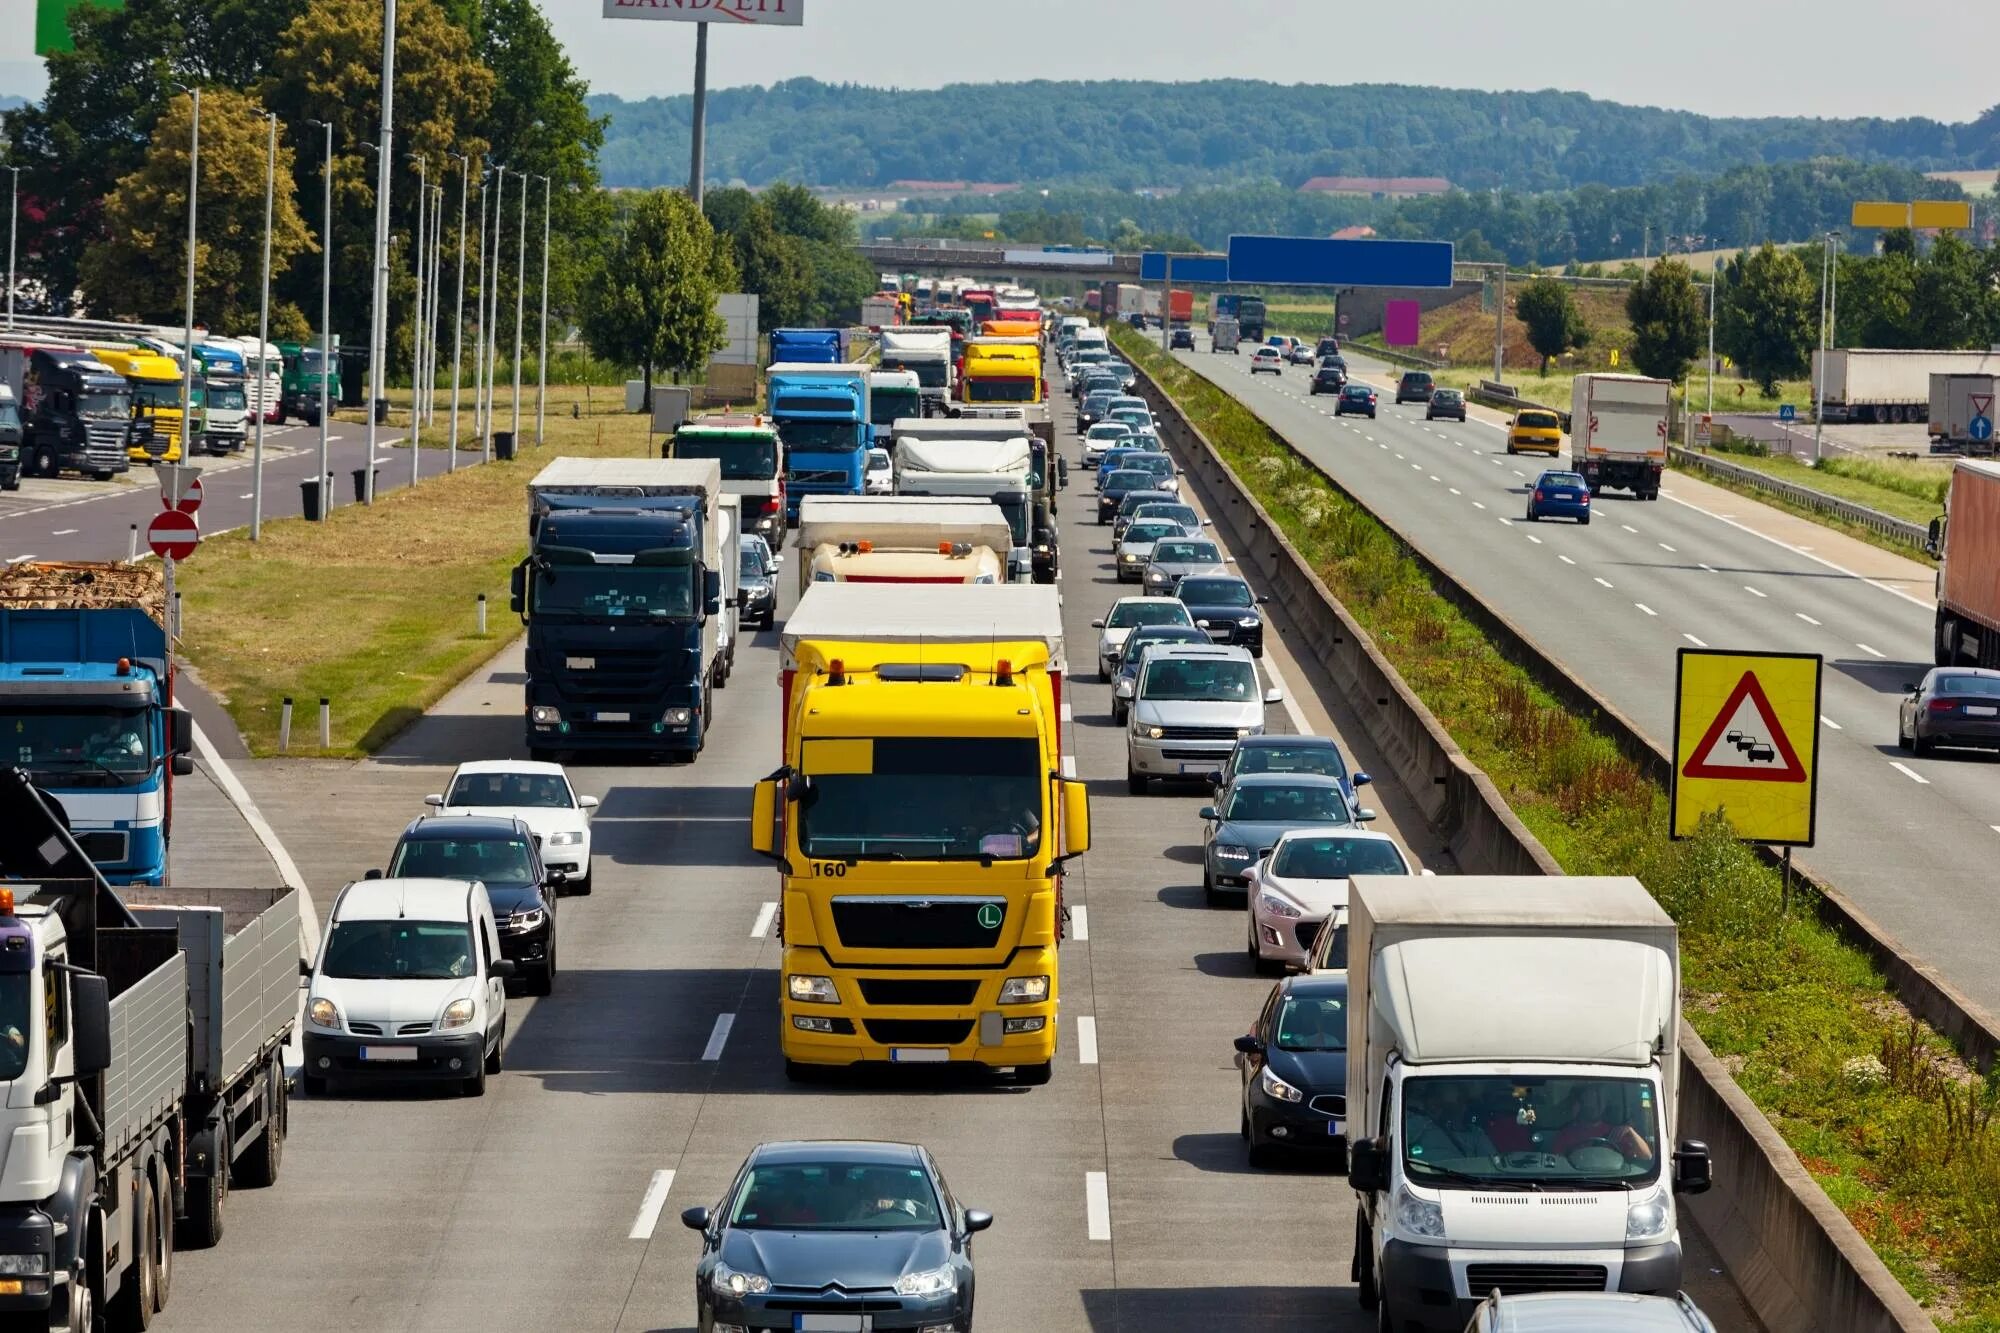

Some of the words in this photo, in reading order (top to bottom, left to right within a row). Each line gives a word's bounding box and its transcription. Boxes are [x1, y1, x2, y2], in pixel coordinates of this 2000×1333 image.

[561, 722, 568, 733] V
[655, 722, 662, 733] L
[813, 862, 846, 877] 160
[985, 907, 997, 924] L
